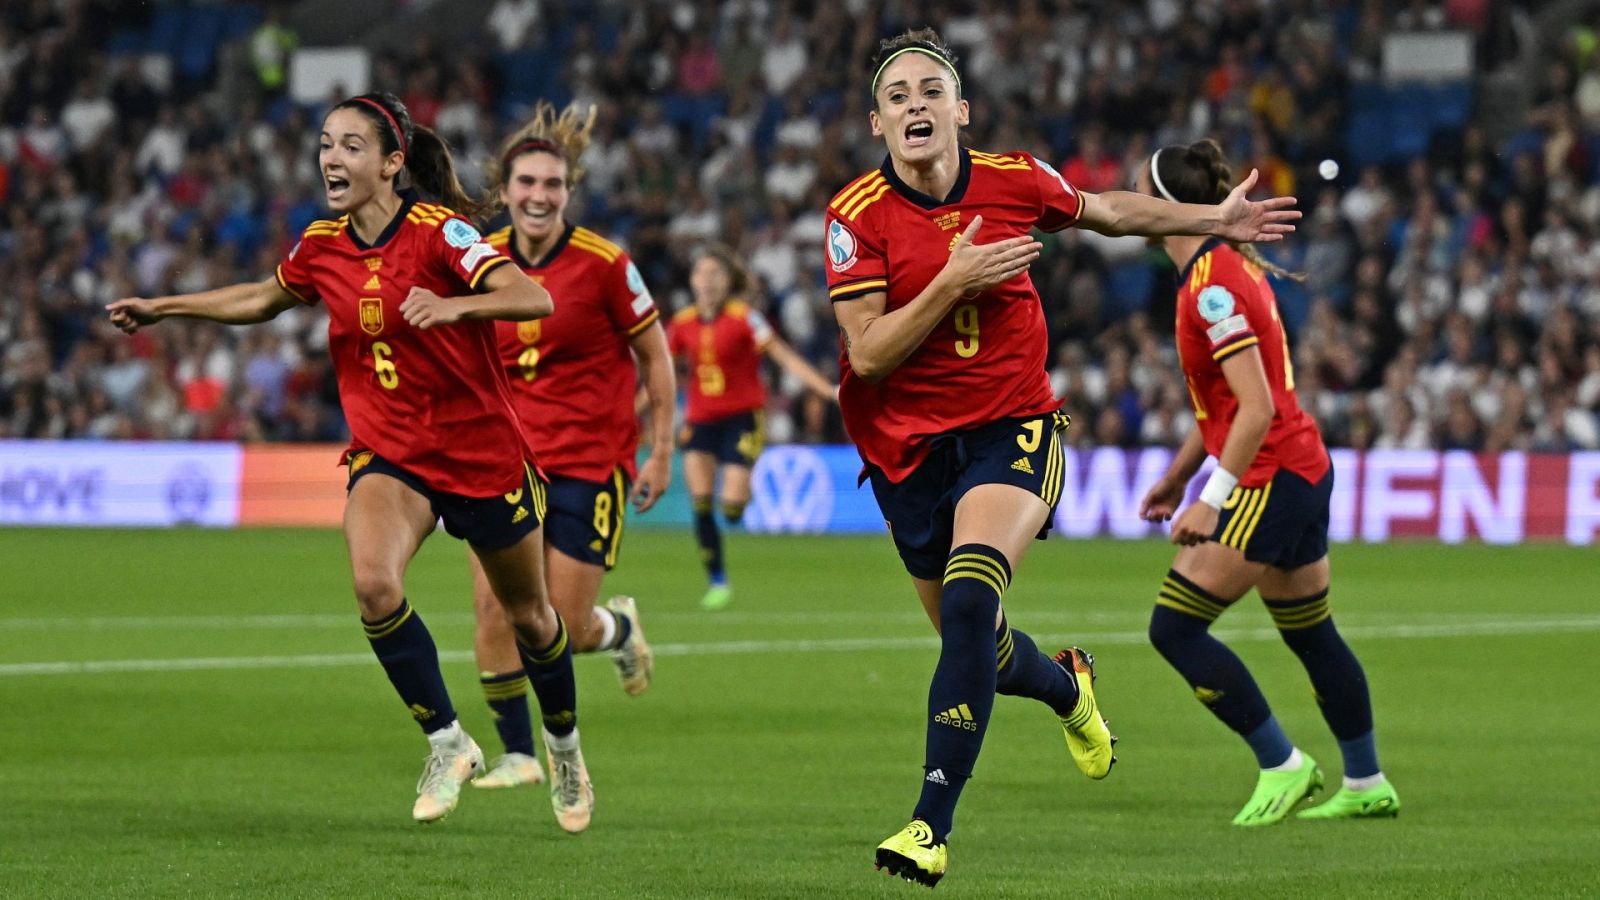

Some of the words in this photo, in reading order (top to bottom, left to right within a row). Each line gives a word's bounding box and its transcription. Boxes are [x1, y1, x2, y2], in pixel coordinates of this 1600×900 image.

[954, 304, 980, 358] 9
[372, 341, 399, 390] 6
[593, 491, 612, 539] 8
[934, 714, 977, 731] adidas
[926, 775, 949, 785] adidas
